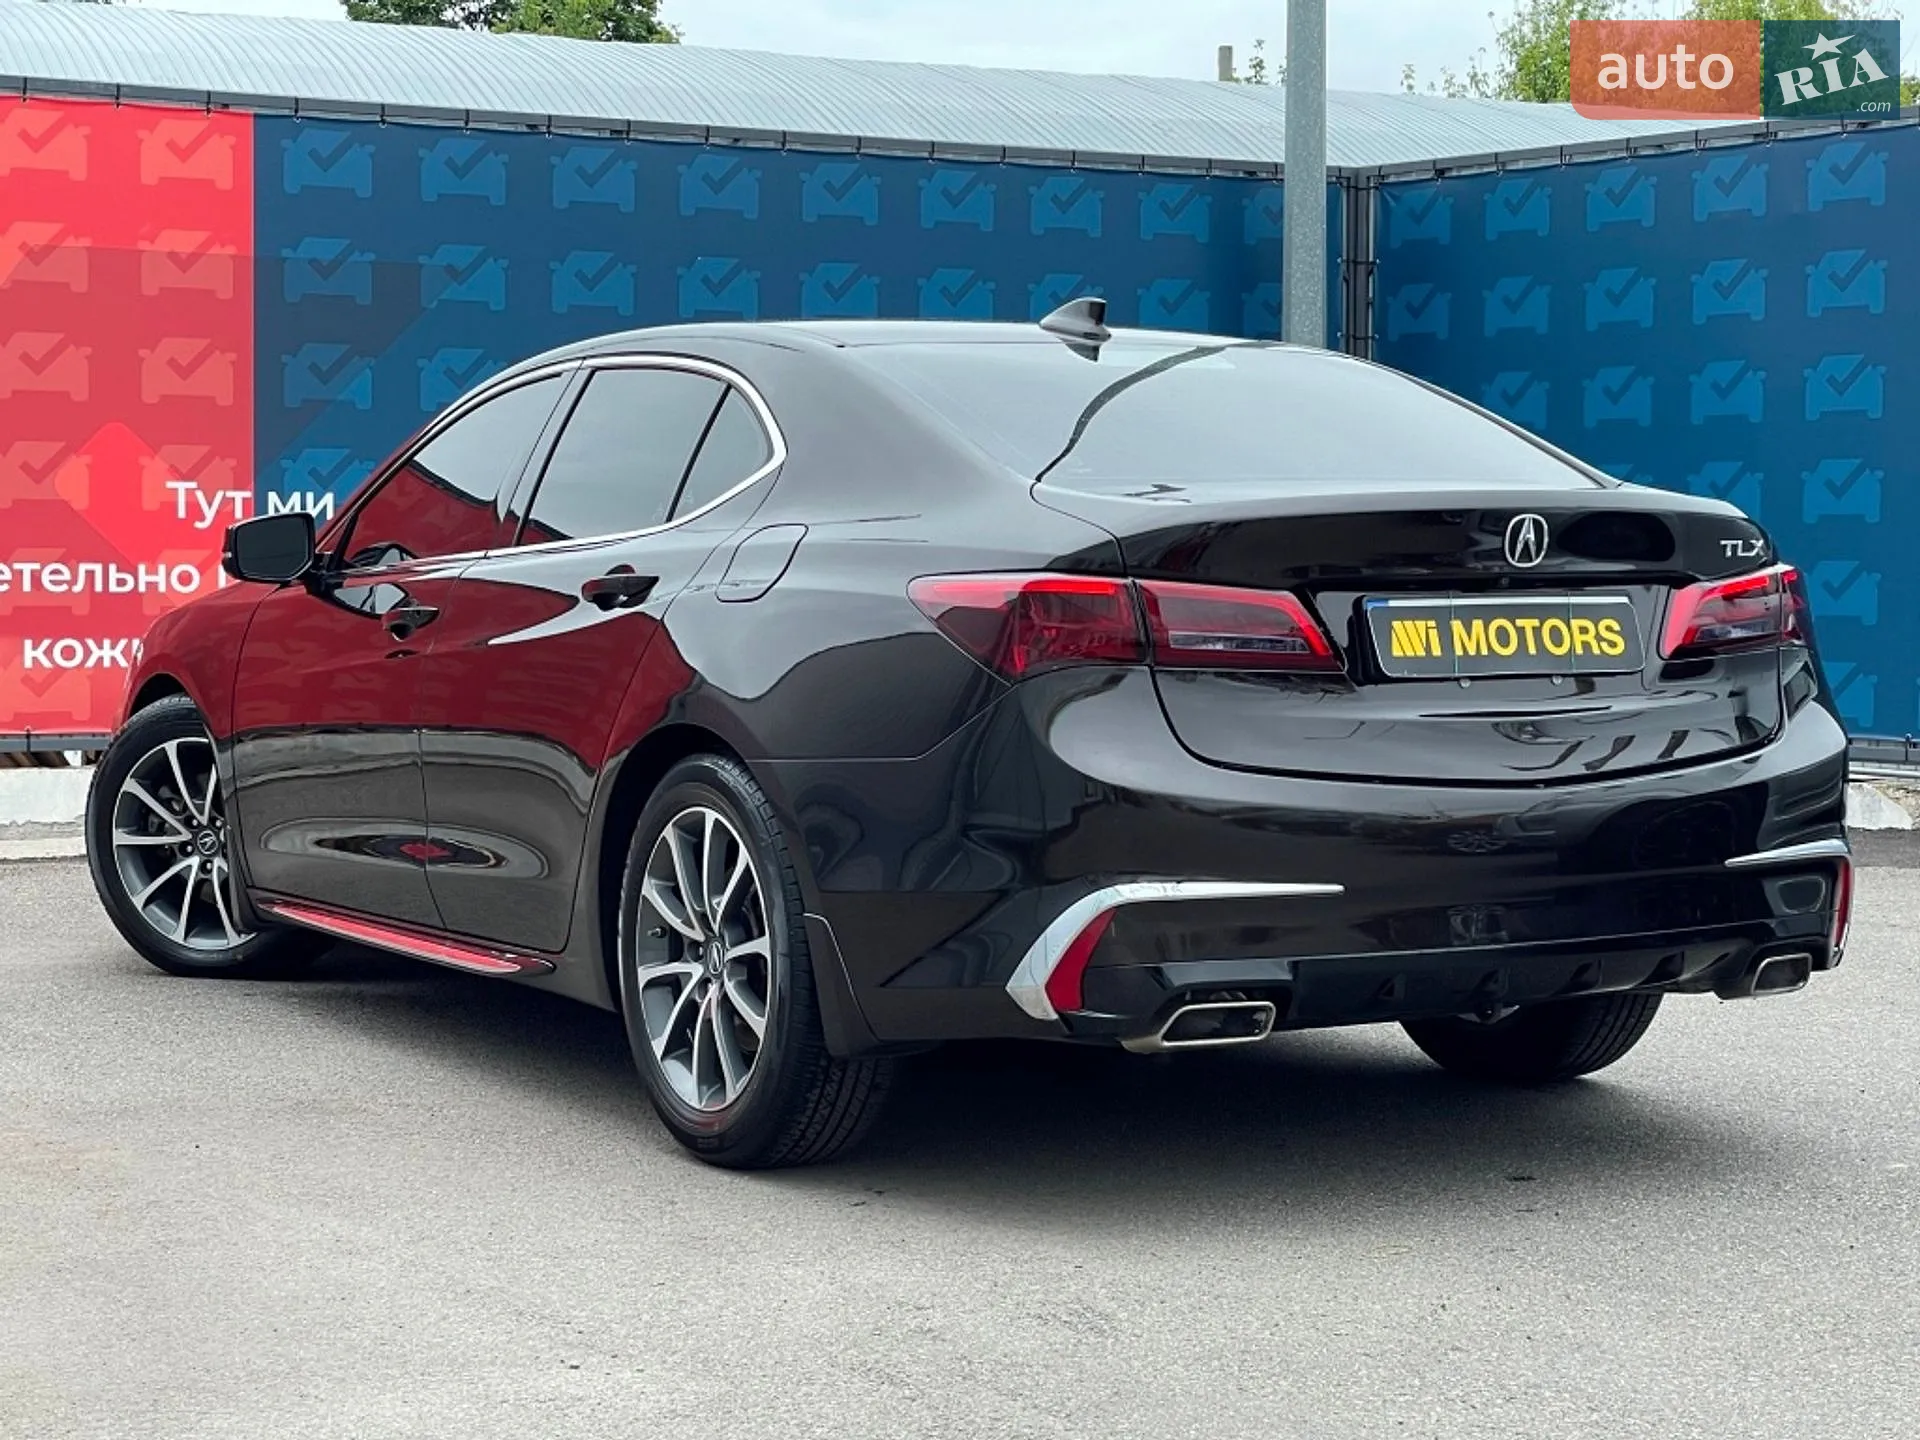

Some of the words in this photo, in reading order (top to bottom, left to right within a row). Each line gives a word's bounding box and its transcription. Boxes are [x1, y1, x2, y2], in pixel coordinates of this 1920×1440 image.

[165, 480, 252, 529] Тут
[267, 491, 334, 520] ми
[1719, 539, 1765, 557] TLX
[1450, 617, 1626, 657] MOTORS
